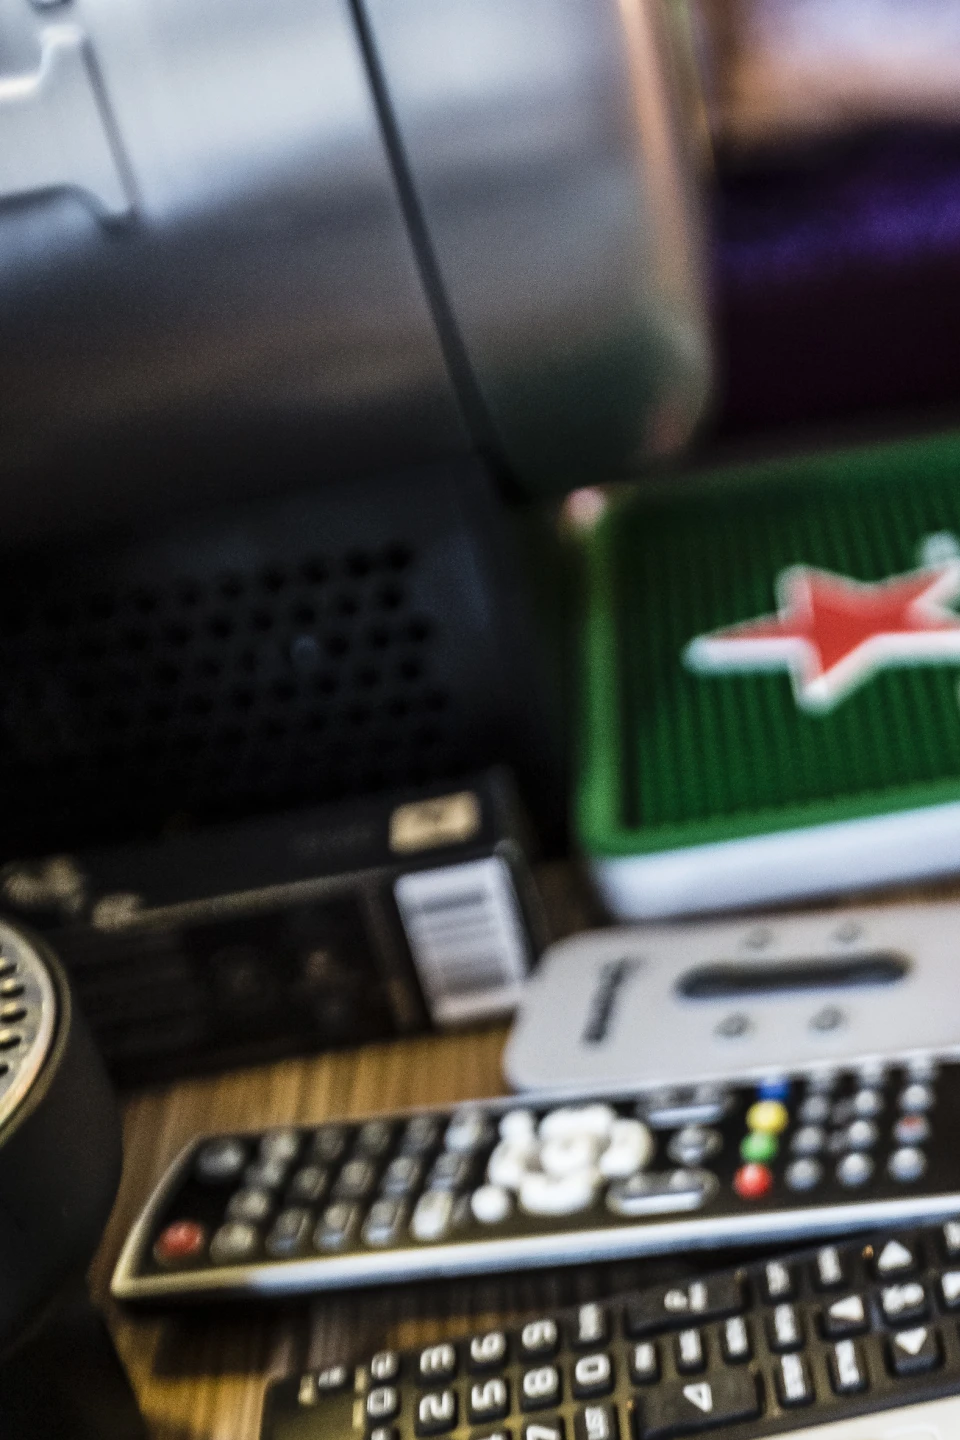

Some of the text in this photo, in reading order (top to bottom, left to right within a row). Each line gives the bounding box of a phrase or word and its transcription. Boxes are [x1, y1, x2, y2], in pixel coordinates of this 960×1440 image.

[471, 1332, 506, 1363] 6
[521, 1320, 557, 1349] 9
[420, 1344, 455, 1374] 3
[575, 1353, 610, 1383] 0
[471, 1379, 507, 1410] 5
[523, 1366, 558, 1397] 8
[419, 1390, 455, 1424] 2
